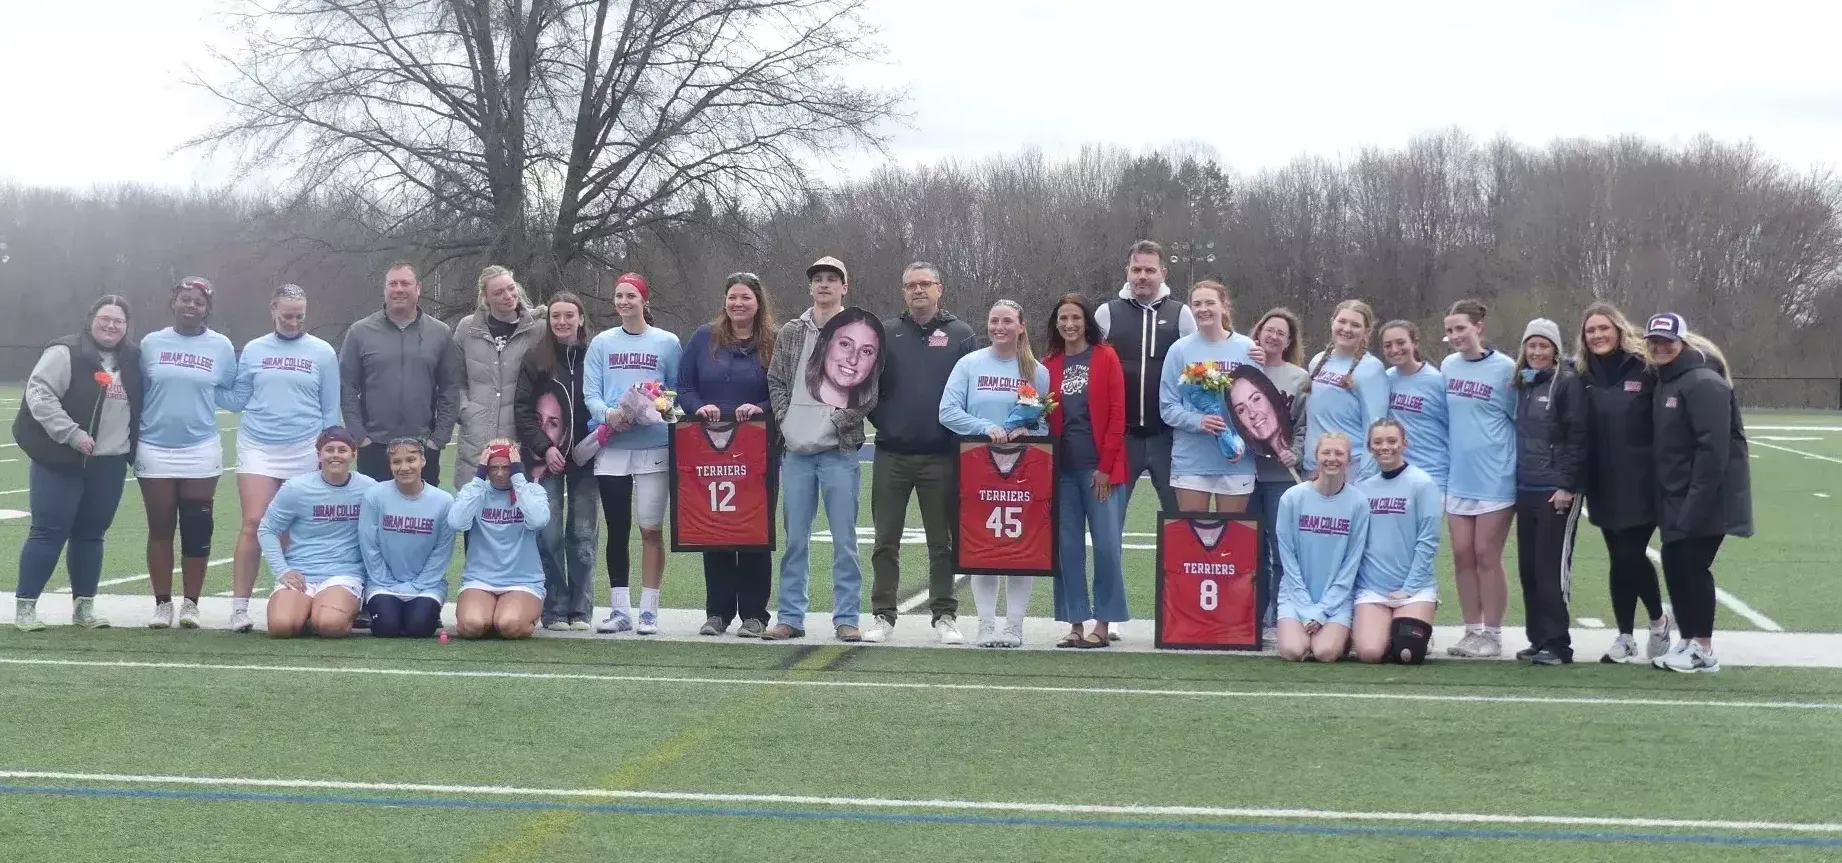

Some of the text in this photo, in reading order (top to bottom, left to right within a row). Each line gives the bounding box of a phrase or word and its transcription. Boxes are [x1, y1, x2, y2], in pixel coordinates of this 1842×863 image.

[160, 352, 214, 370] HIRAM COLLEGE
[262, 357, 312, 371] HIRAM COLLEGE
[609, 353, 658, 367] HIRAM COLLEGE
[978, 376, 999, 387] HIRAM
[1465, 380, 1493, 398] COLLEGE
[1396, 394, 1424, 410] COLLEGE
[696, 465, 747, 477] TERRIERS
[708, 481, 736, 511] 12
[979, 489, 1030, 502] TERRIERS
[313, 504, 361, 517] HIRAM COLLEG
[1379, 497, 1407, 511] COLLEGE
[482, 507, 502, 520] HIRAM
[383, 514, 434, 531] HIRAM COLLEGE
[985, 506, 1023, 538] 45
[1299, 514, 1350, 532] HIRAM COLLEGE
[1183, 562, 1235, 575] TERRIERS
[1199, 579, 1218, 611] 8
